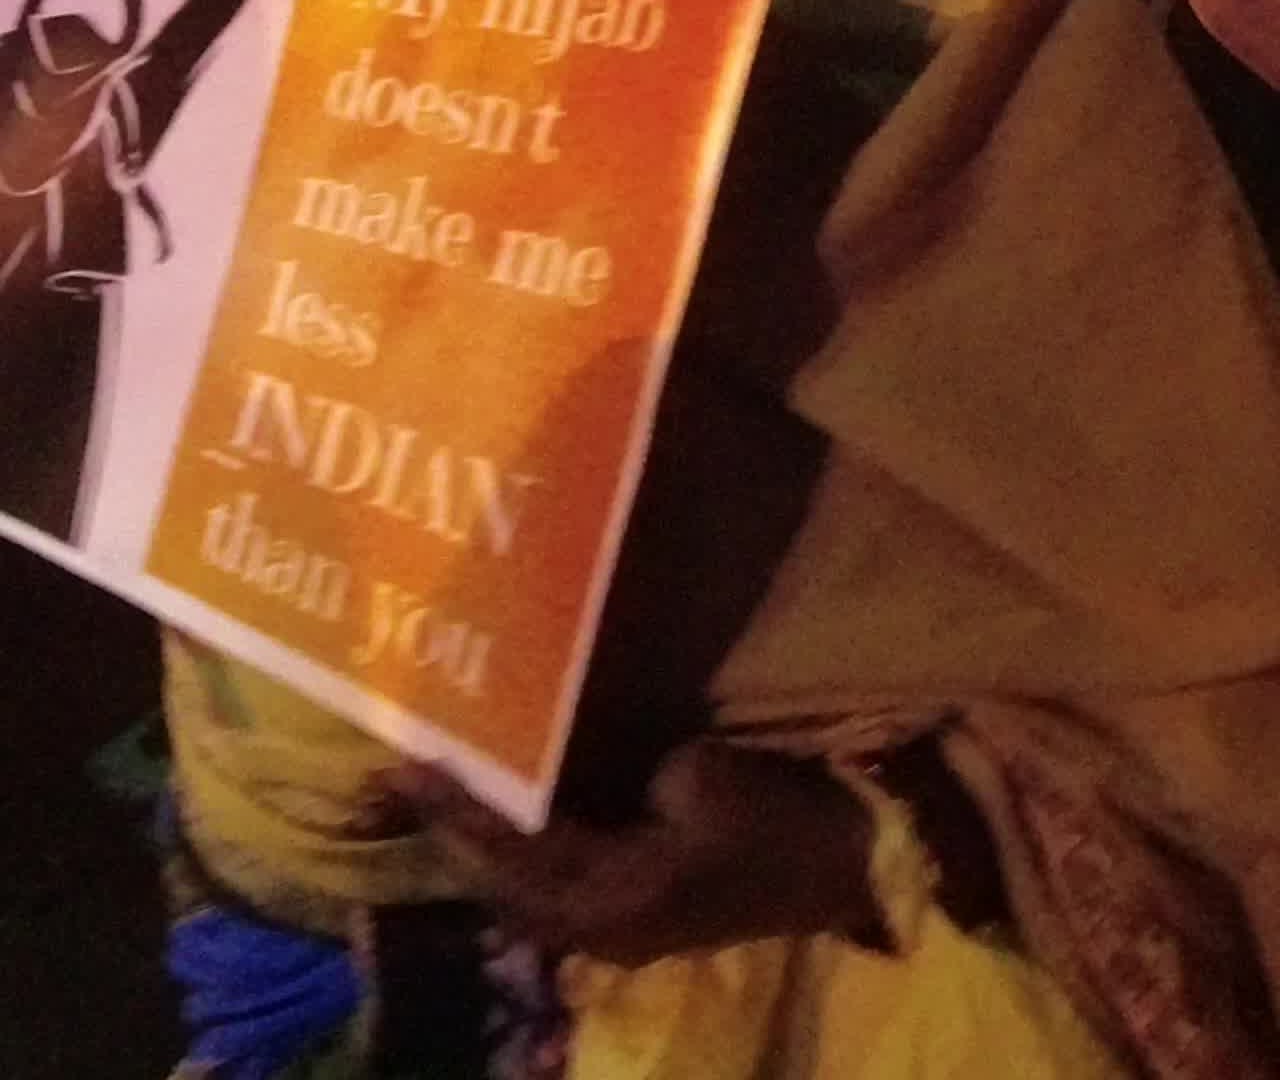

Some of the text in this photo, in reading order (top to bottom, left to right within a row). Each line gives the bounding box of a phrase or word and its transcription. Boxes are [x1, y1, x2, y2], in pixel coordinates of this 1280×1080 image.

[256, 258, 378, 368] less
[293, 175, 611, 307] make me
[201, 369, 545, 556] INDIAN
[200, 493, 493, 699] than you
